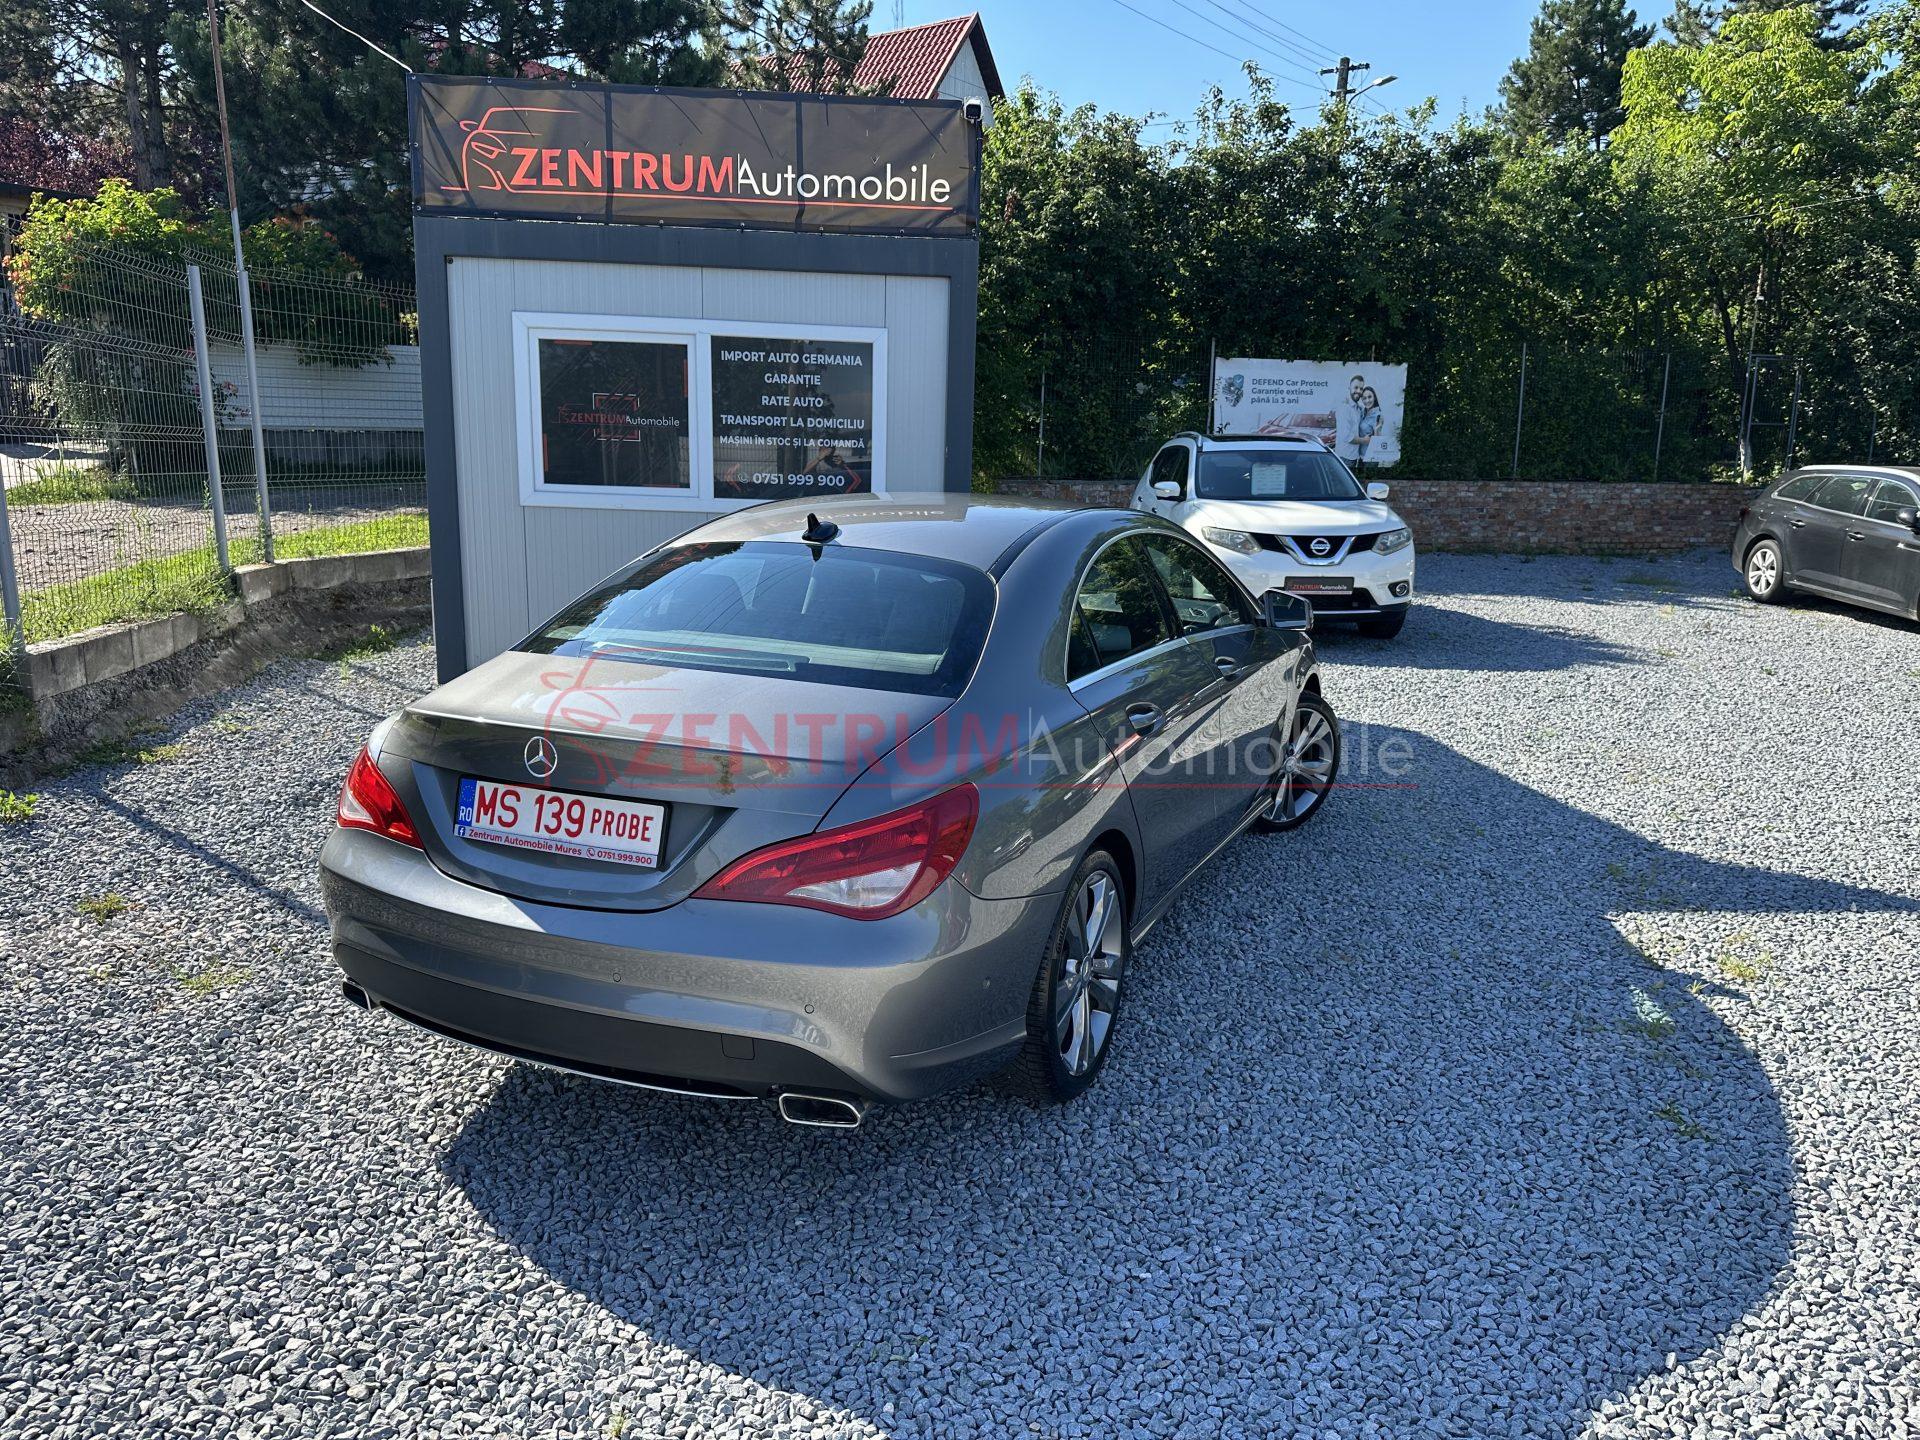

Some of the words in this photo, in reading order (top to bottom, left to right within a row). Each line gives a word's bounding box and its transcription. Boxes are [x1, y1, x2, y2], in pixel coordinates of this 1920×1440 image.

[510, 147, 733, 193] ZENTRUM
[737, 153, 950, 203] Automobile
[720, 351, 765, 362] IMPORT
[768, 353, 799, 364] AUTO
[802, 354, 863, 366] GERMANIA
[764, 373, 821, 387] GARANȚIE
[1251, 378, 1284, 386] DEFEND
[1286, 379, 1299, 387] Car
[1286, 387, 1314, 395] extinsă
[761, 395, 790, 406] RATE
[793, 397, 823, 407] AUTO
[571, 413, 626, 424] ZENTRUM
[625, 416, 680, 426] Automobile
[720, 414, 787, 427] TRANSPORT
[790, 417, 804, 428] LA
[807, 418, 865, 429] DOMICILIU
[720, 436, 753, 447] MAȘINI
[754, 434, 764, 445] ÎN
[767, 437, 790, 446] STOC
[793, 438, 801, 448] ȘI
[804, 438, 815, 447] LA
[817, 437, 865, 448] COMANDĂ
[752, 473, 784, 485] 0751
[788, 474, 814, 486] 999
[818, 475, 845, 487] 900
[459, 806, 472, 821] RO
[475, 786, 521, 829] MS
[534, 794, 585, 838] 139
[590, 808, 654, 842] PROBE
[468, 829, 502, 842] Zentrum
[504, 836, 553, 851] Automobile
[555, 844, 582, 856] Mures
[597, 850, 652, 865] 0751.999.900
